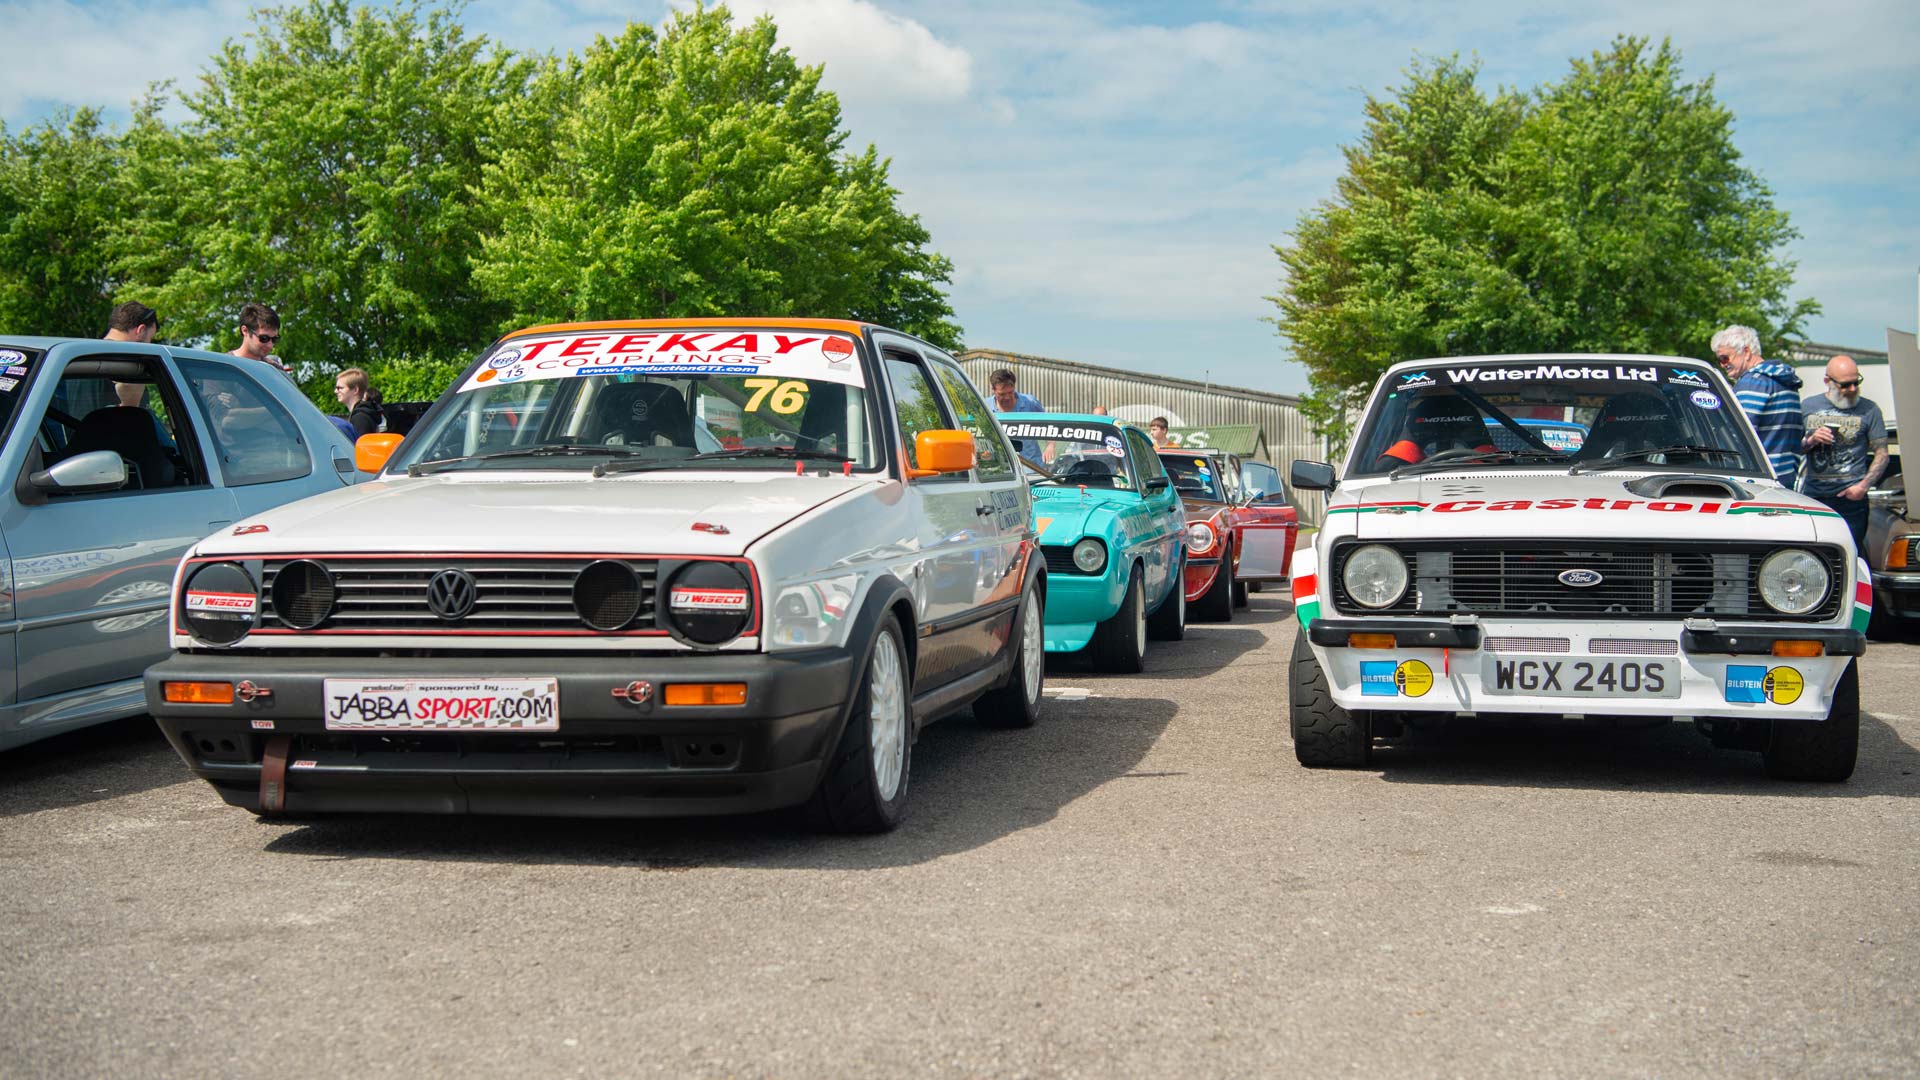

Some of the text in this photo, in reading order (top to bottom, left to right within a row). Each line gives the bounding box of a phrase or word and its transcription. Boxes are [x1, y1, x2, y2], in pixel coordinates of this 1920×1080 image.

[521, 333, 822, 361] TEEKAY
[536, 353, 772, 370] COUPLINGS
[580, 364, 758, 375] www.ProductionGTI.com
[1446, 365, 1658, 384] WaterMota Ltd
[744, 378, 810, 415] 76
[1423, 415, 1474, 423] MOTAMEC
[1615, 414, 1669, 422] MOTAMEC
[1568, 571, 1593, 582] Ford
[204, 597, 254, 608] WISECO
[691, 594, 744, 604] WISECO
[1362, 674, 1395, 683] BILSTEIN
[1496, 660, 1665, 693] WGX 240S
[418, 684, 480, 692] sponsored
[1727, 679, 1762, 689] BILSTEIN
[254, 720, 272, 728] TOW
